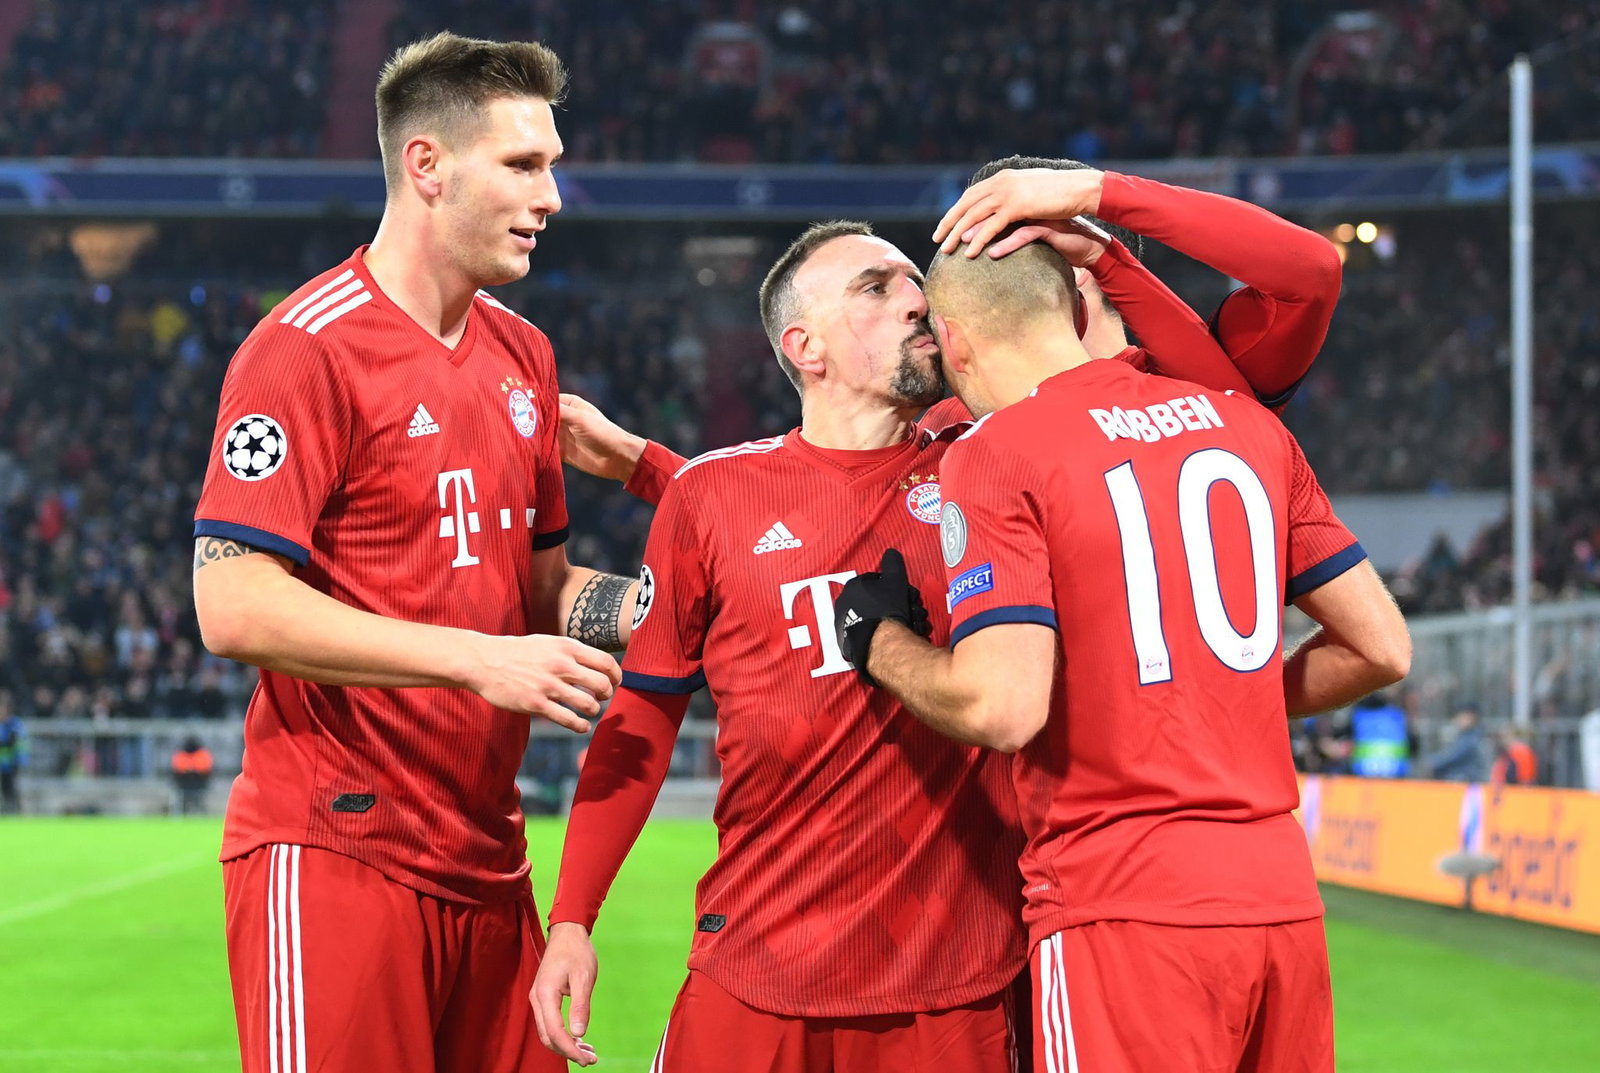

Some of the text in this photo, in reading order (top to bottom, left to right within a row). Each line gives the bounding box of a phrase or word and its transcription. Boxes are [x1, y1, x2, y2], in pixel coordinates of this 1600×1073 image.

[407, 422, 440, 438] adidas
[1088, 394, 1225, 443] ROBBEN
[917, 485, 941, 495] BAYE
[437, 468, 481, 569] T
[753, 538, 803, 555] adidas
[949, 570, 991, 600] ESPECT
[1103, 447, 1280, 687] 10
[779, 570, 857, 679] T
